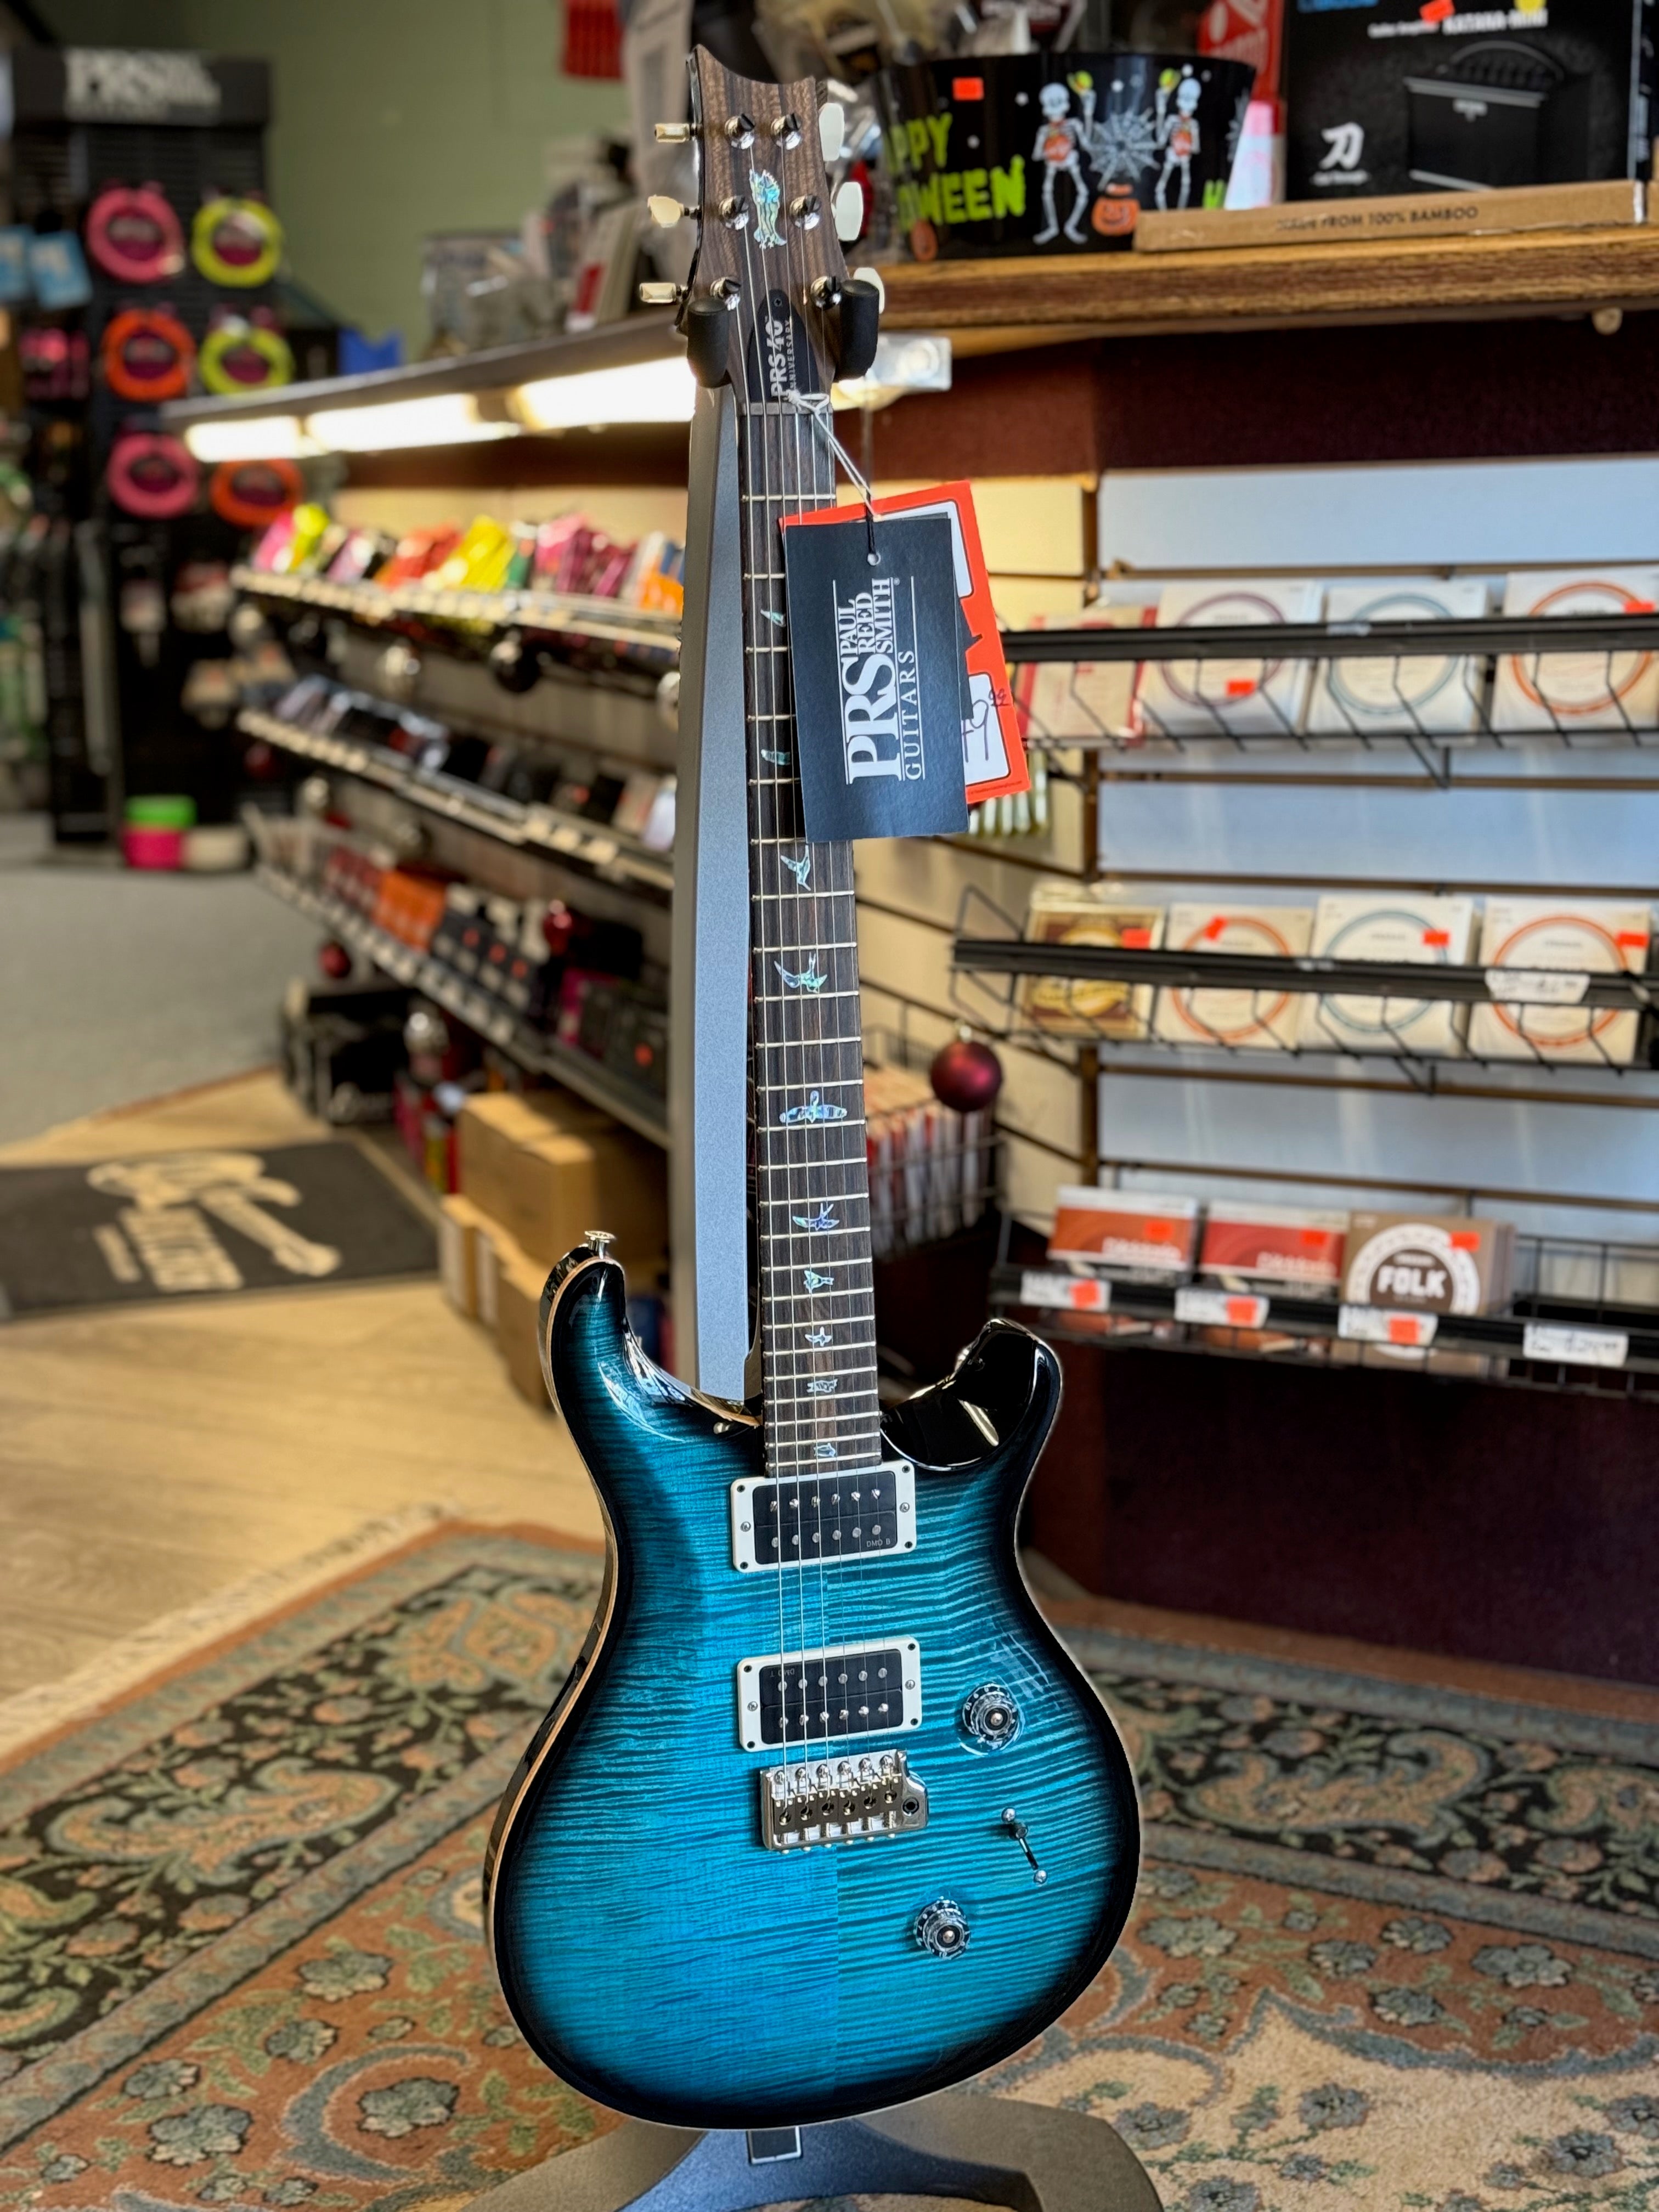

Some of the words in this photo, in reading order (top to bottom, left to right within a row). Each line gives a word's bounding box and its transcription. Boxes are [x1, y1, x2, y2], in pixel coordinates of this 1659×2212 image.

[1321, 214, 1362, 228] FROM
[1368, 212, 1405, 225] 100%
[1410, 206, 1479, 223] BAMBOO
[765, 319, 785, 352] 40
[785, 319, 797, 389] NNIVERSARY
[768, 353, 787, 397] PRS
[838, 598, 858, 656] PAUL
[855, 592, 876, 654] REED
[872, 578, 894, 653] SMITH
[841, 653, 902, 785] PRS
[898, 651, 922, 781] GUITARS
[1377, 1265, 1447, 1299] FOLK
